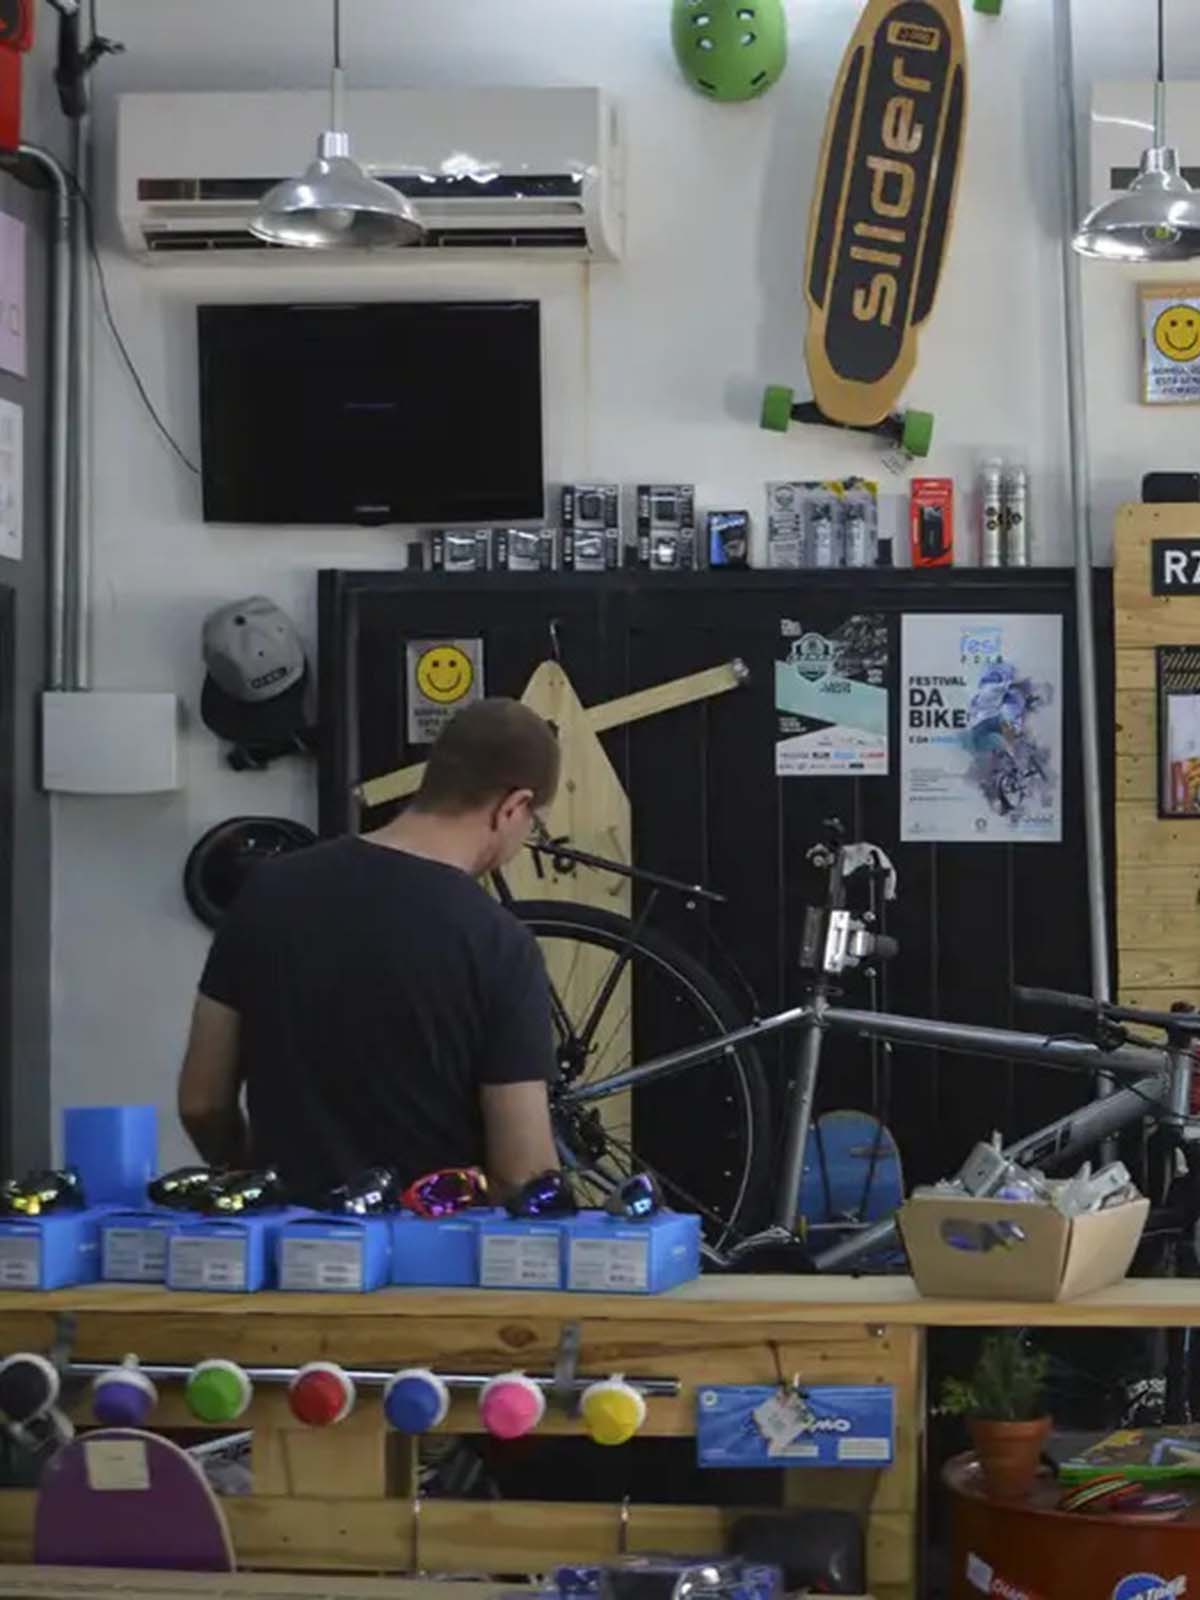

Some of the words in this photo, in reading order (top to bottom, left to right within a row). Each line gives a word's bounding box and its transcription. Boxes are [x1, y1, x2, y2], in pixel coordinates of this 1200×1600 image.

[908, 676, 967, 687] FESTIVAL
[909, 688, 944, 707] DA
[909, 709, 967, 729] BIKE
